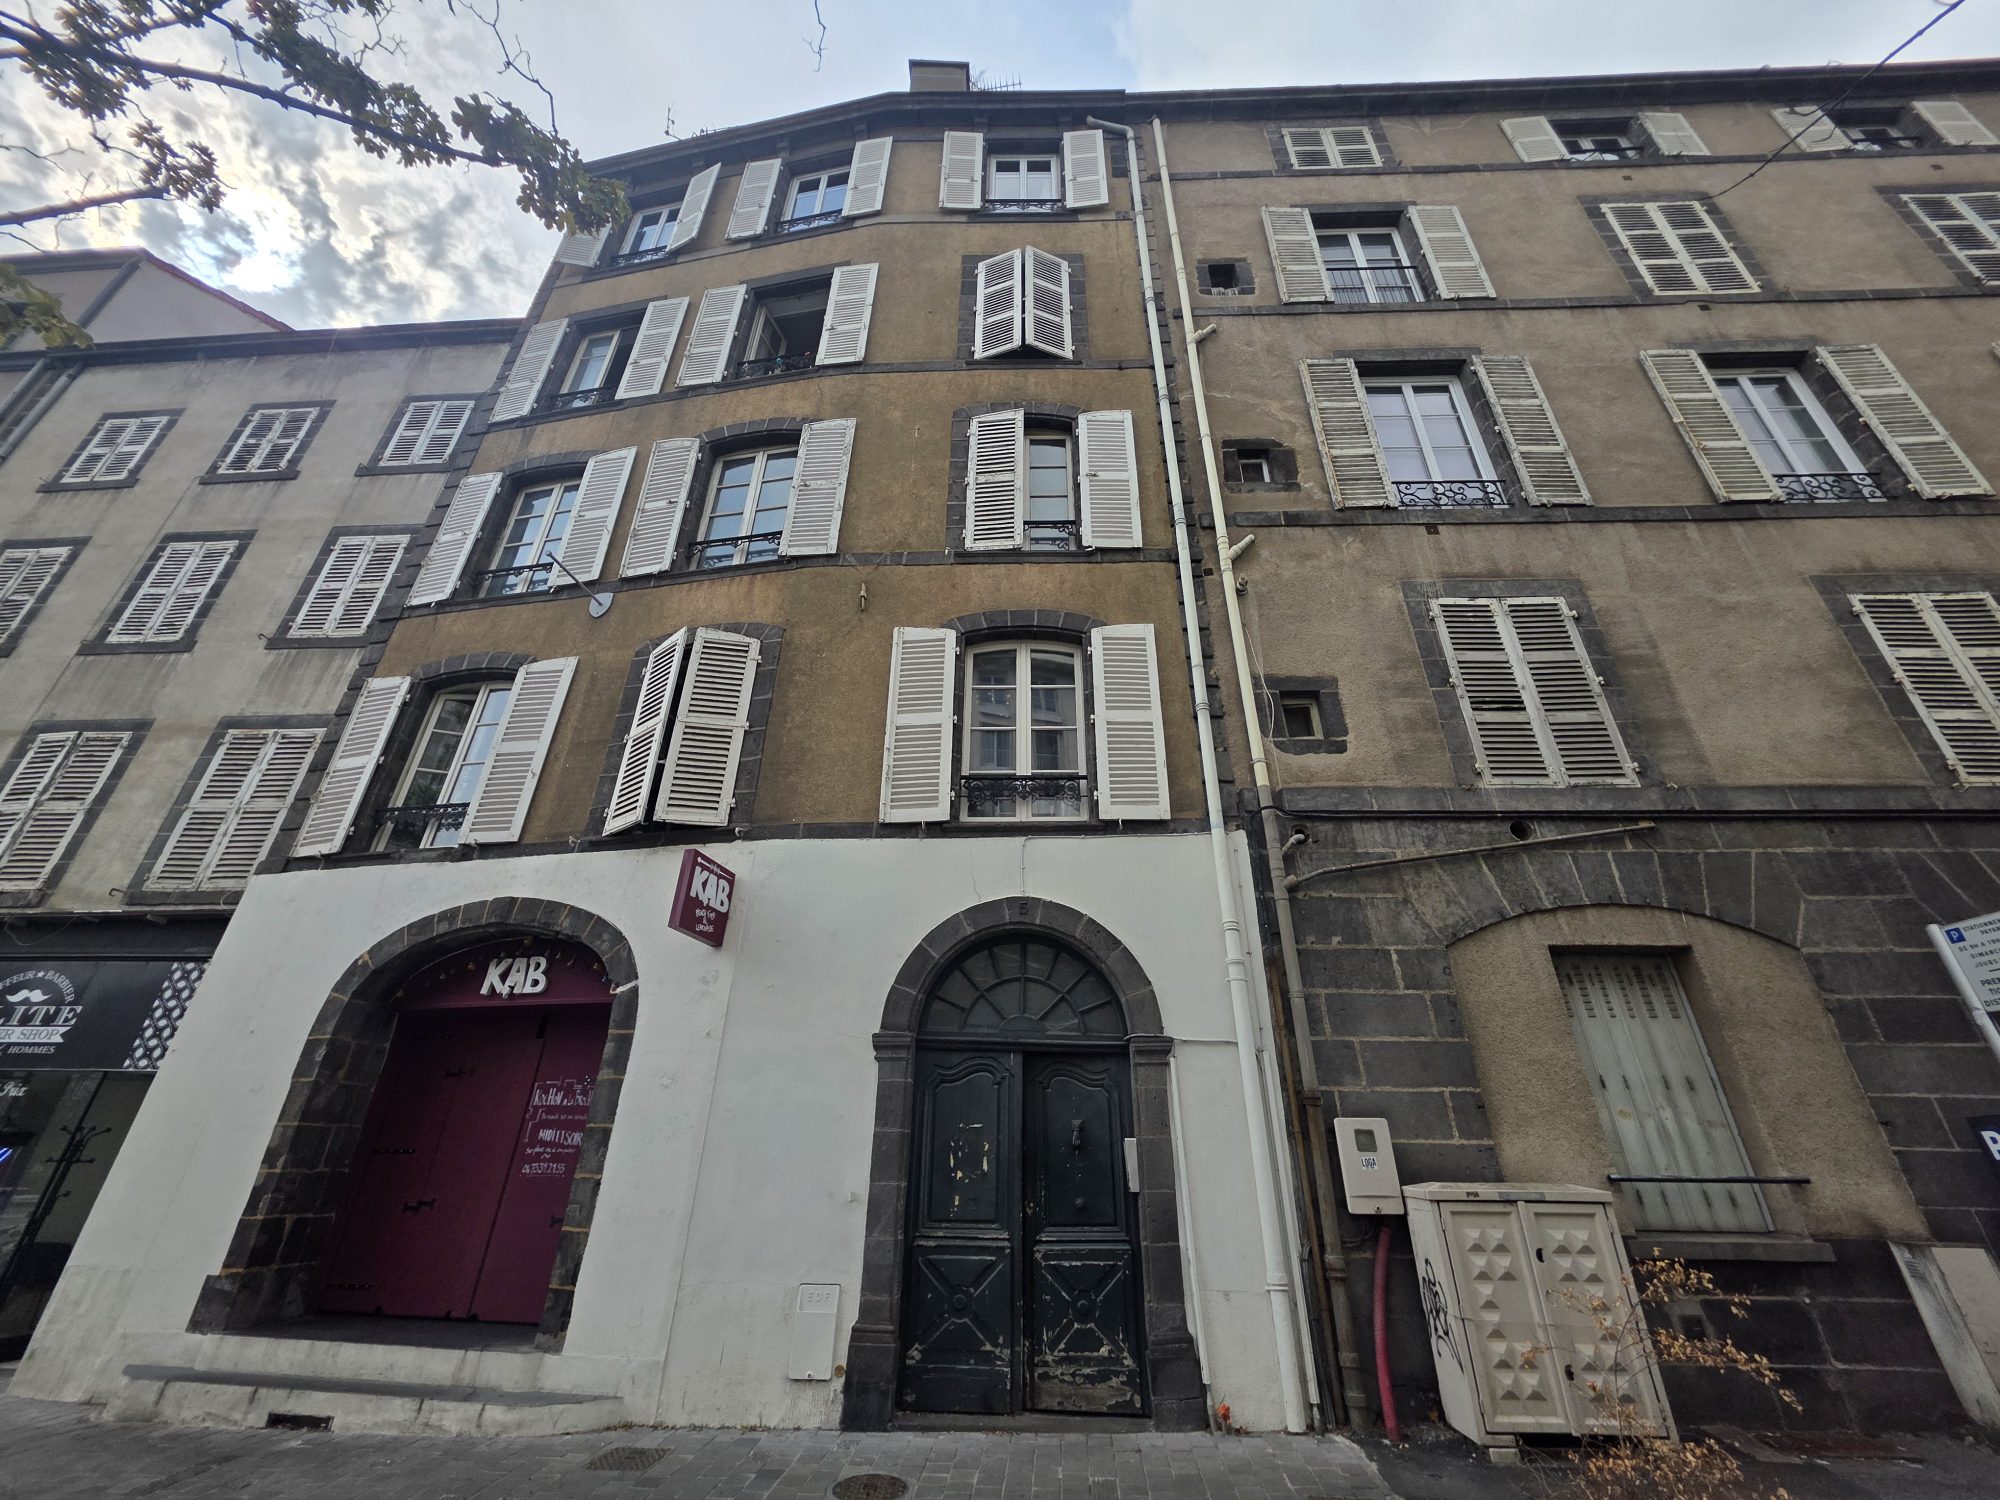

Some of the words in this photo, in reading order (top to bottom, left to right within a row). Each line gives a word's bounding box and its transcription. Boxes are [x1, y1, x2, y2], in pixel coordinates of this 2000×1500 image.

[690, 865, 730, 913] KAB
[44, 970, 75, 1004] BARBIER
[479, 956, 548, 999] KAB
[7, 1045, 56, 1055] HOMMES
[18, 1028, 60, 1040] SHOP
